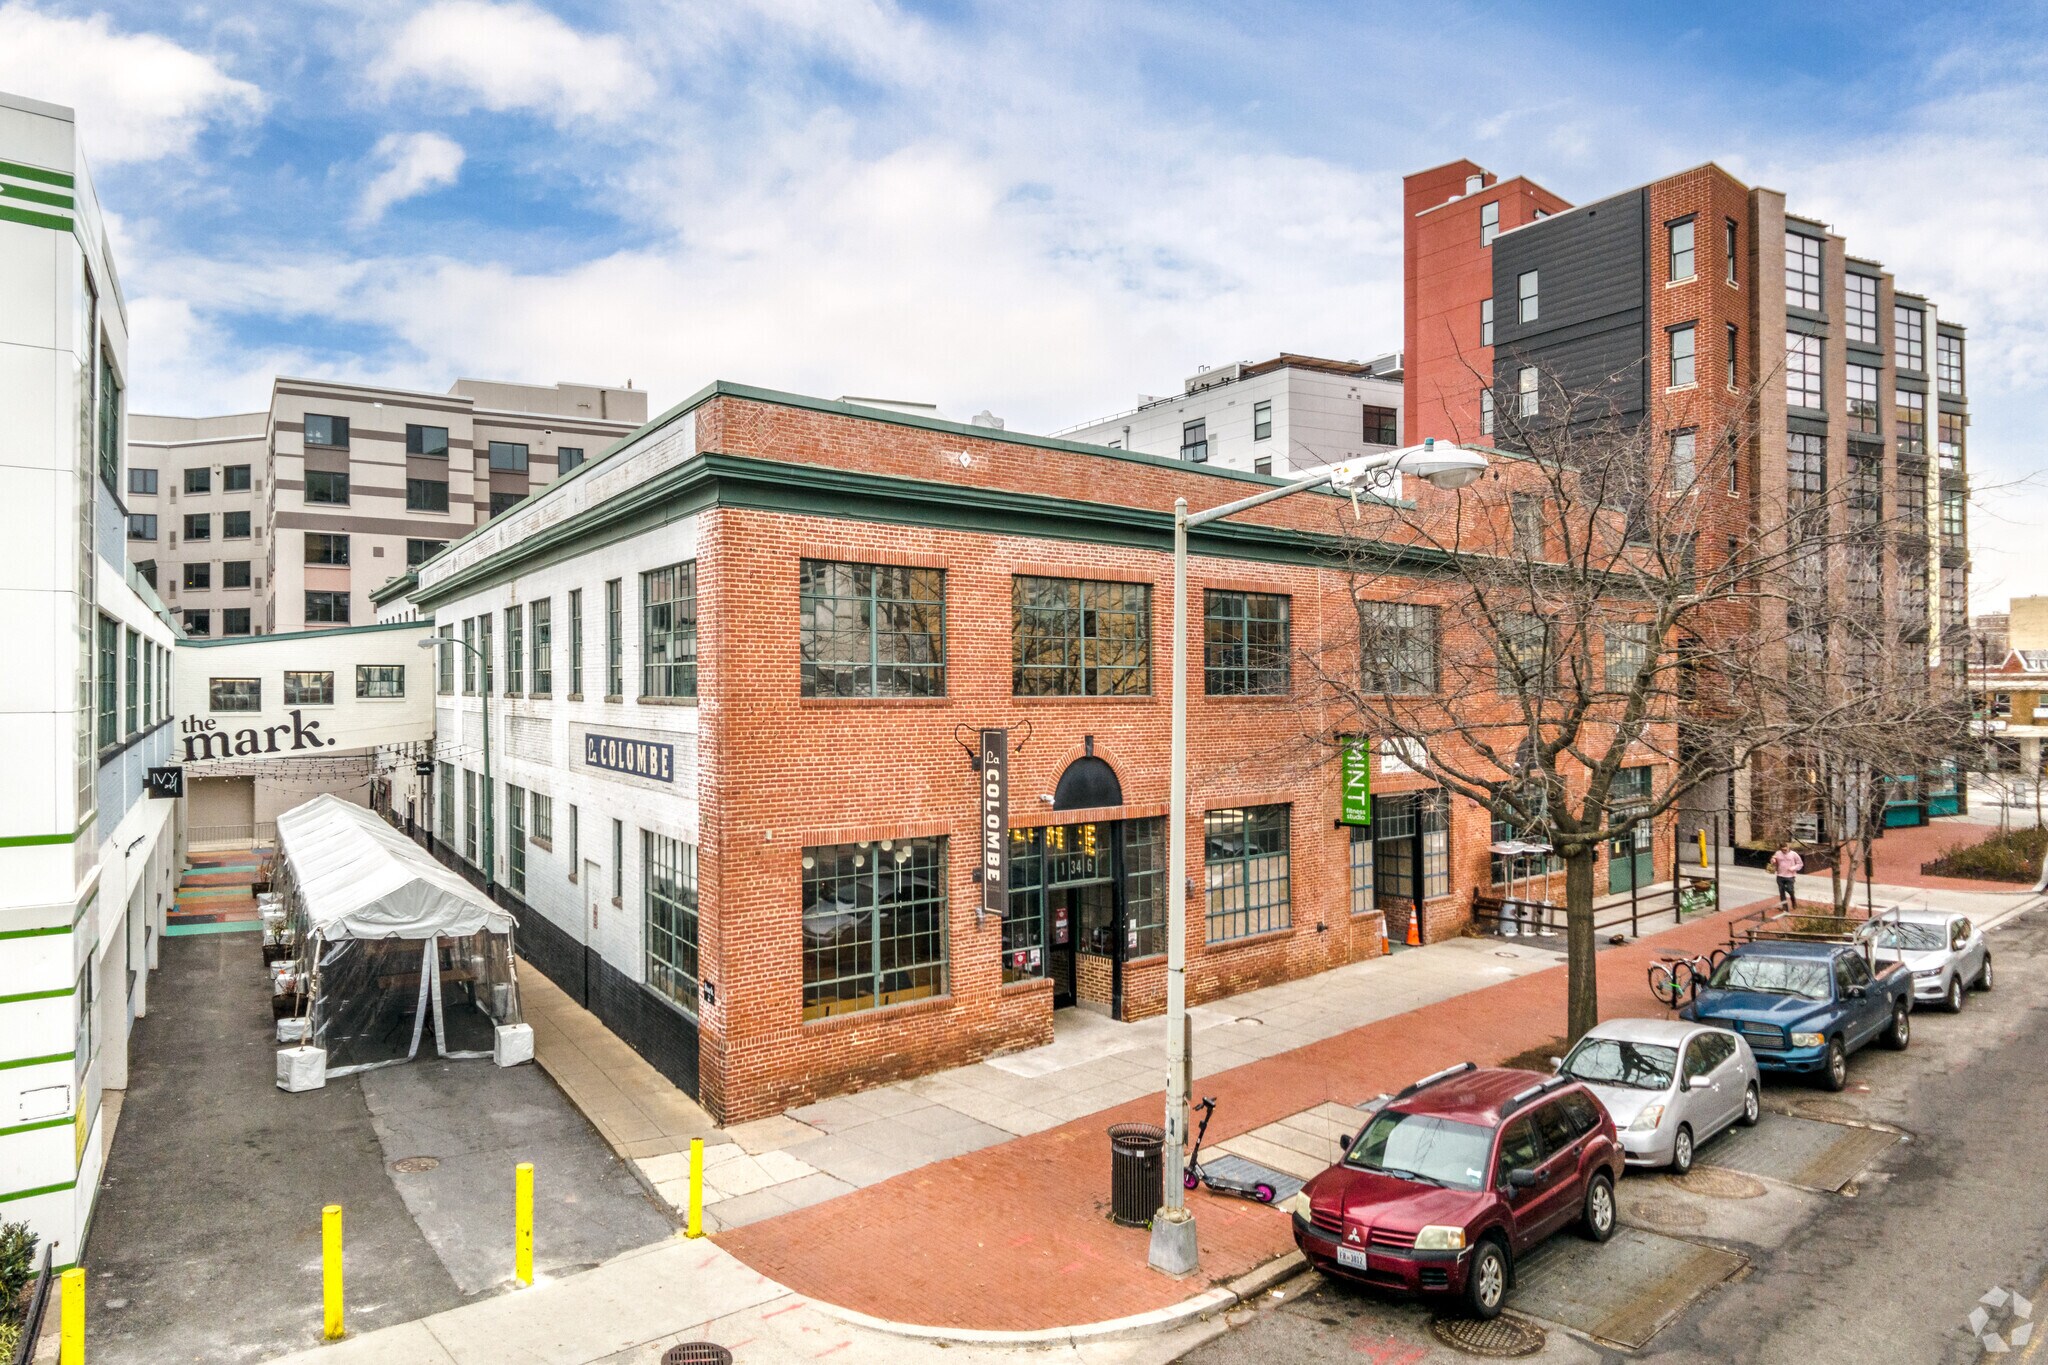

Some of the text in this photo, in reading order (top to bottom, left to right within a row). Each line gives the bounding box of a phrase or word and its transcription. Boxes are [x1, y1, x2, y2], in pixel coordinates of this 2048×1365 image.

[181, 714, 216, 734] the
[182, 709, 336, 762] mark.
[588, 737, 669, 778] La COLOMBE
[986, 750, 1000, 764] La
[152, 772, 177, 784] IVY
[1347, 742, 1365, 806] MINT
[986, 769, 1000, 881] COLOMBE
[1346, 807, 1366, 815] fitness
